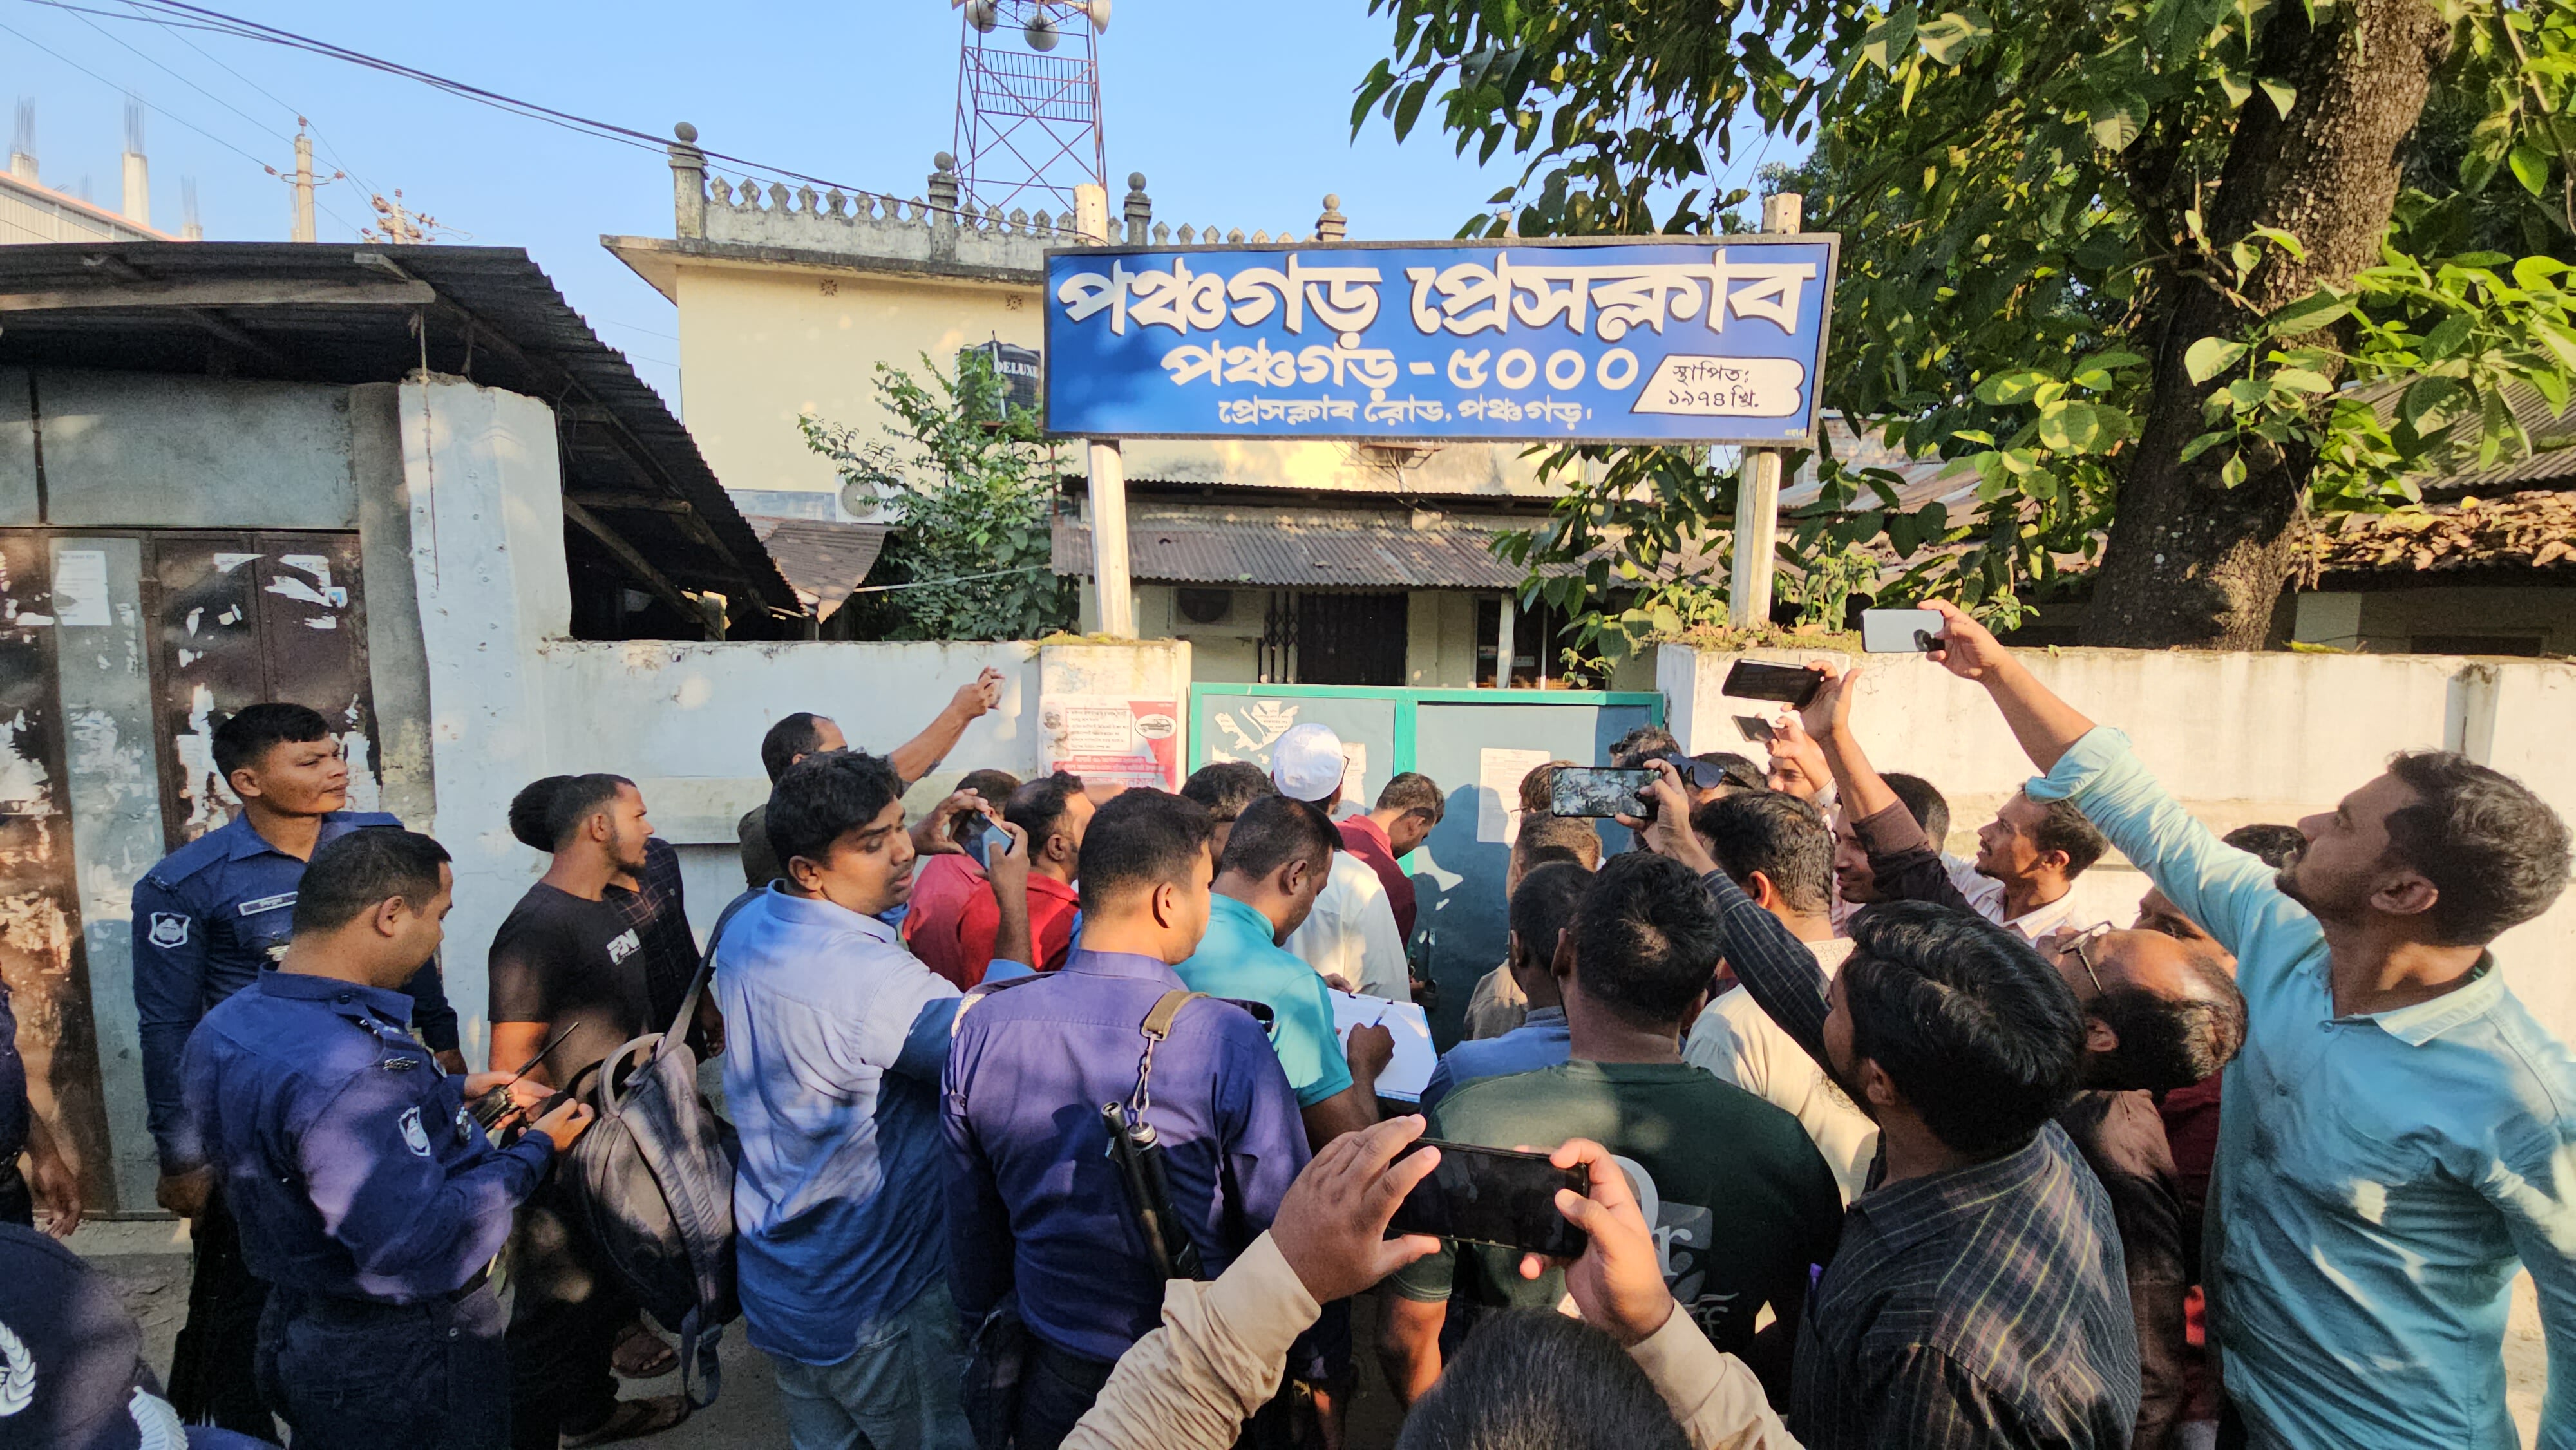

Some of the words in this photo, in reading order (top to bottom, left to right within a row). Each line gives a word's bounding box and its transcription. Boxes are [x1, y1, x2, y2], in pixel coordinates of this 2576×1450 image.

[1057, 254, 1383, 350] পঞ্চগড়
[1406, 248, 1816, 341] প্রেসক্লাব
[1160, 337, 1398, 402] পঞ্চগড়
[1218, 394, 1358, 426] প্রেসক্লাব
[1669, 390, 1725, 407] ১৯৭৪
